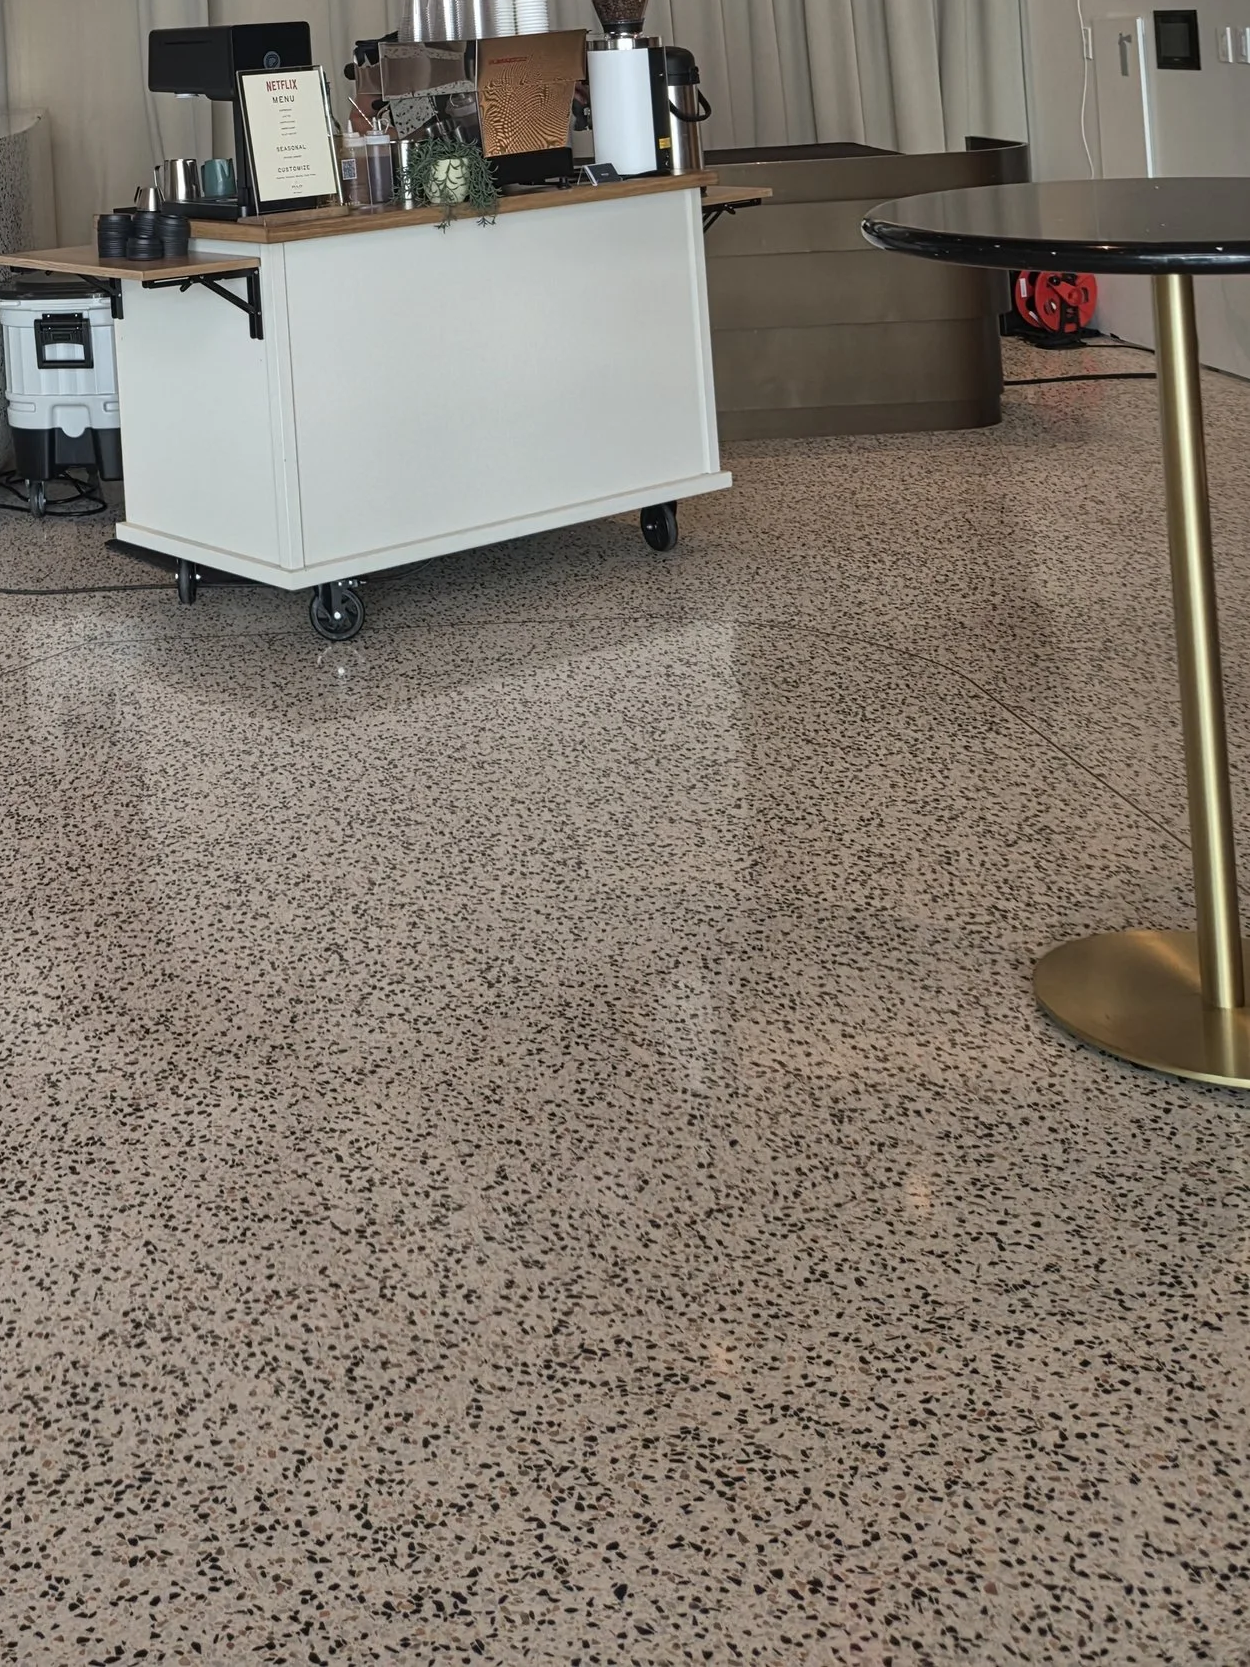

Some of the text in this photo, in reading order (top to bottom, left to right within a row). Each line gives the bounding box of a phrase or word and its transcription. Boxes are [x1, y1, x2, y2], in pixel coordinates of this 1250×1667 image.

[266, 79, 298, 92] NETFLIX
[272, 95, 295, 104] MENU
[276, 144, 307, 152] SEASONAL
[277, 165, 310, 173] CUSTOMIZE
